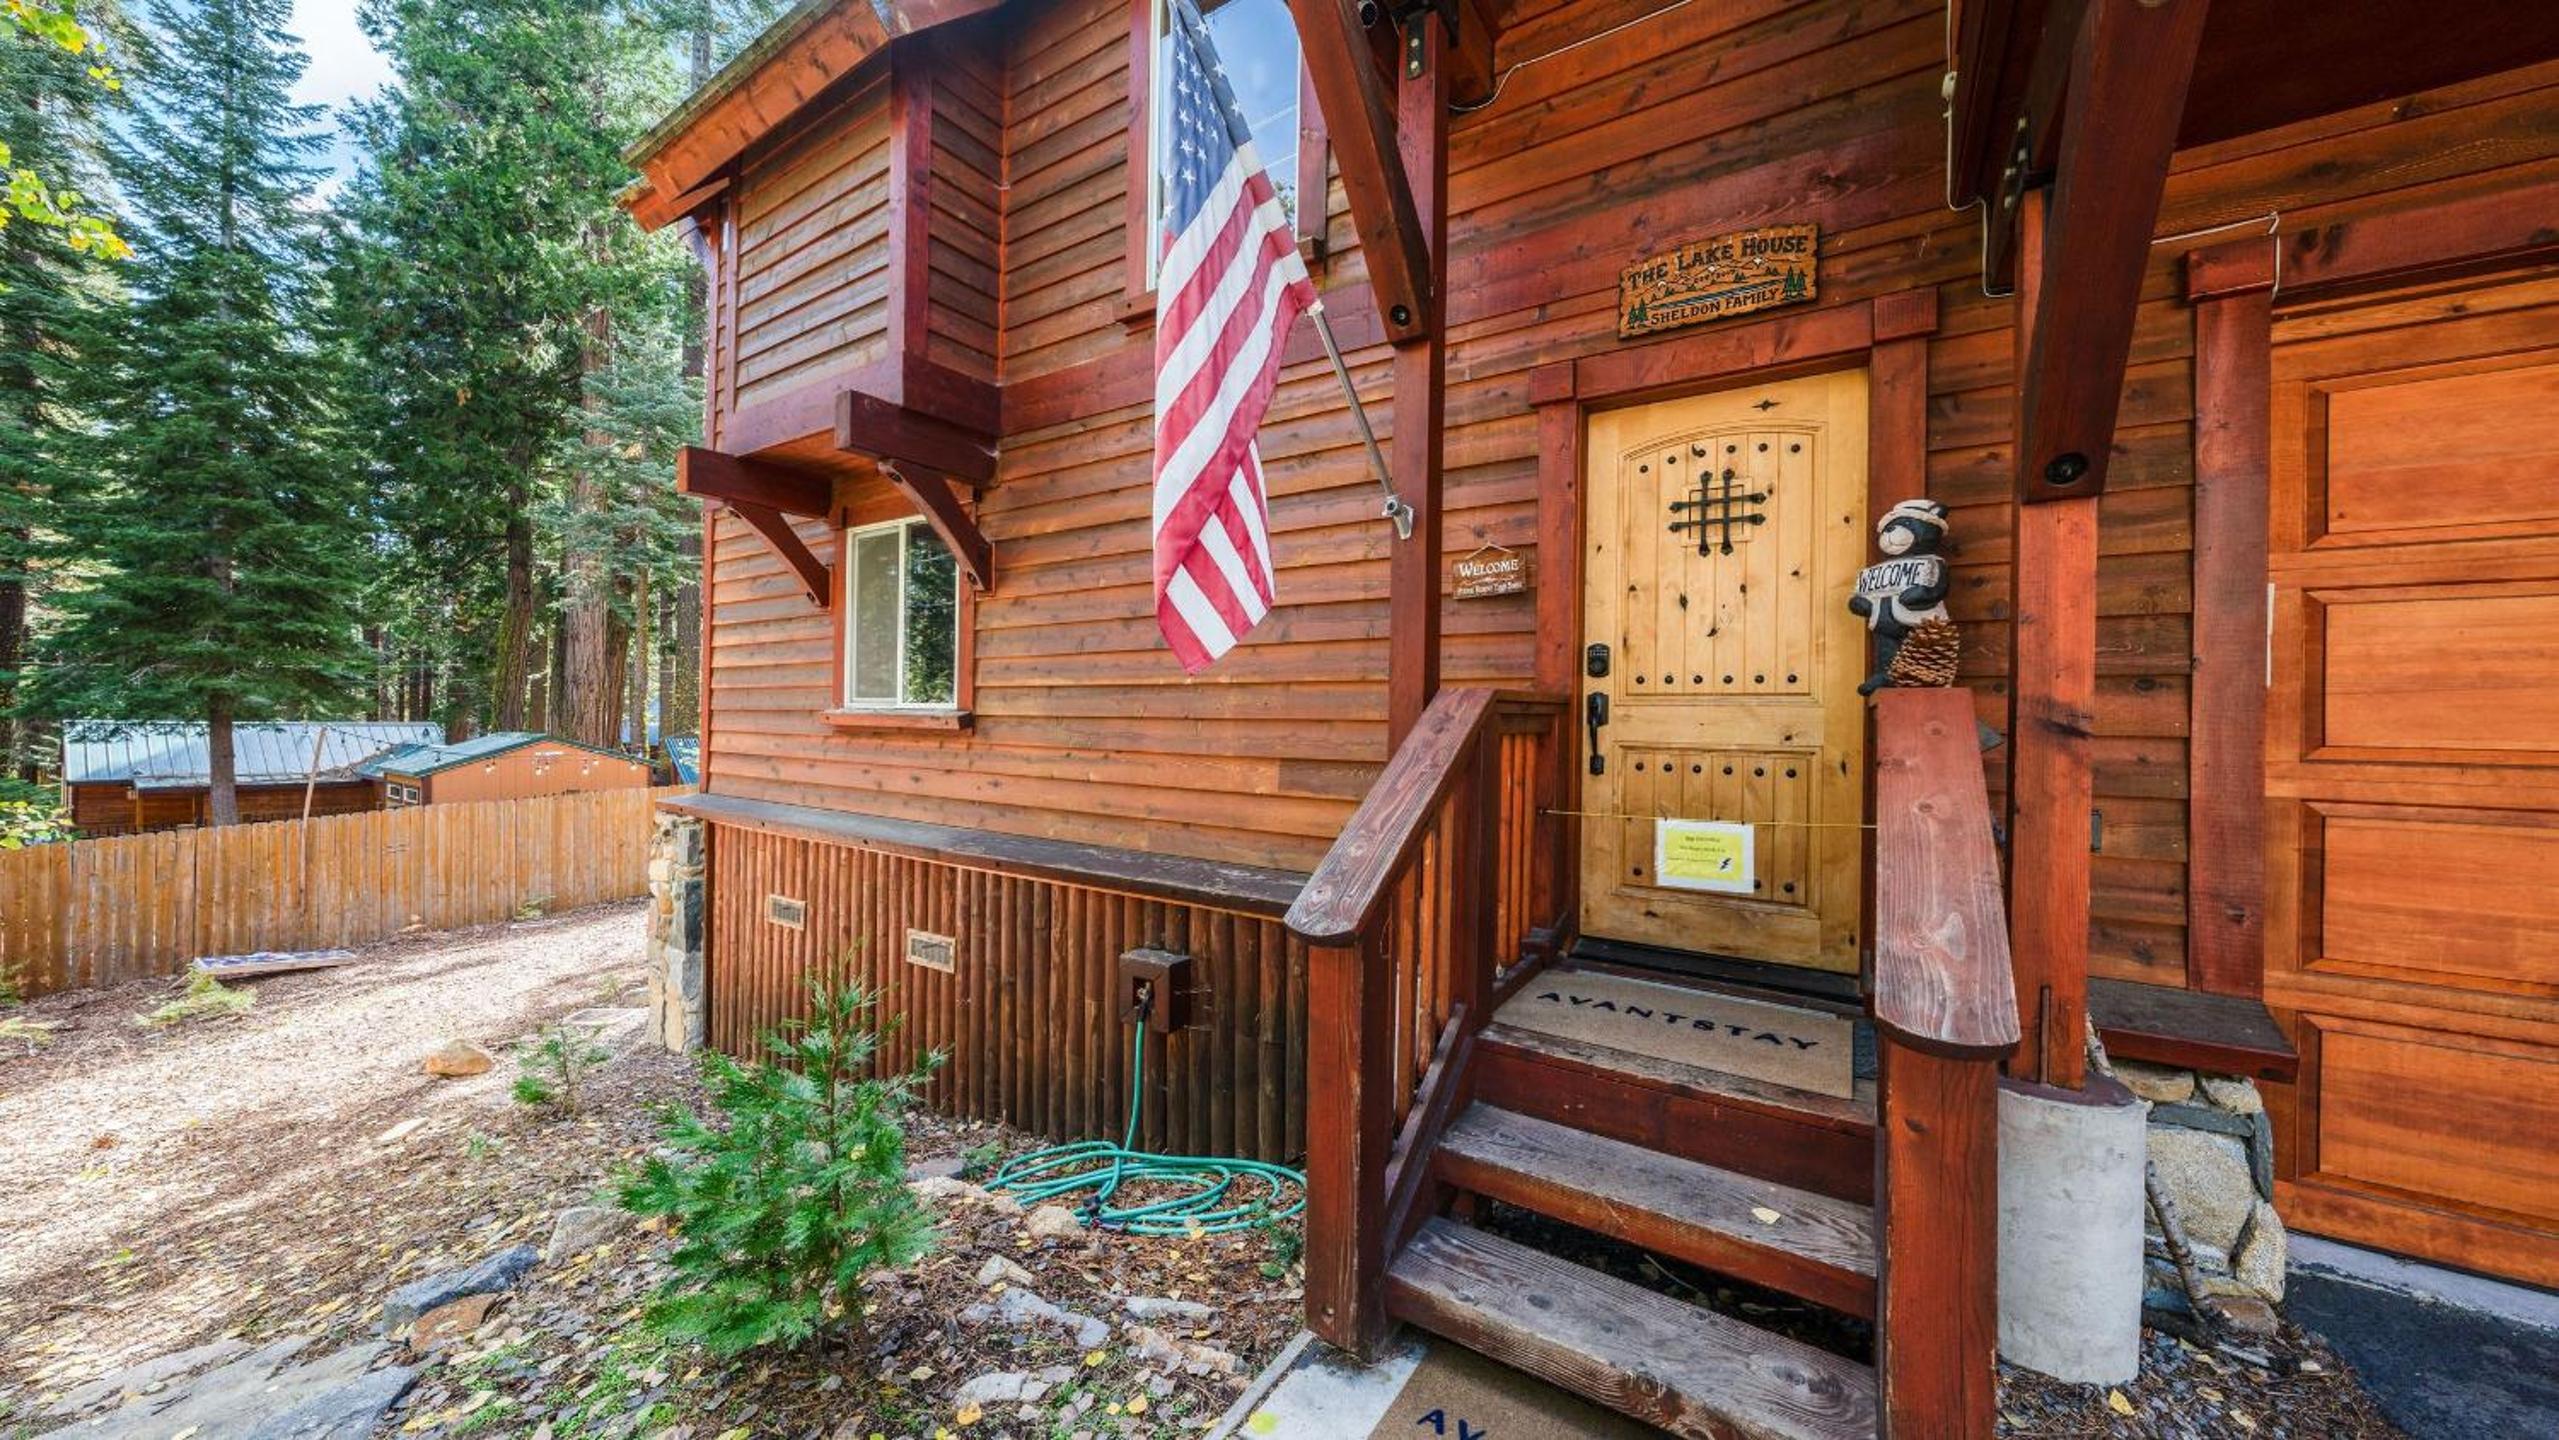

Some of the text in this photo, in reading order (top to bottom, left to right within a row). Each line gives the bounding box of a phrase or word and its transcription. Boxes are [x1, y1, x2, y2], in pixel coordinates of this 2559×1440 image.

[1628, 262, 1668, 290] THE
[1676, 243, 1734, 270] LAKE
[1741, 235, 1809, 257] HOUSE
[1650, 287, 1780, 326] SHELDON FAMILY
[1459, 559, 1520, 577] WELCOME
[1859, 562, 1925, 593] WELCOME
[1536, 991, 1820, 1050] AVANTSTAY
